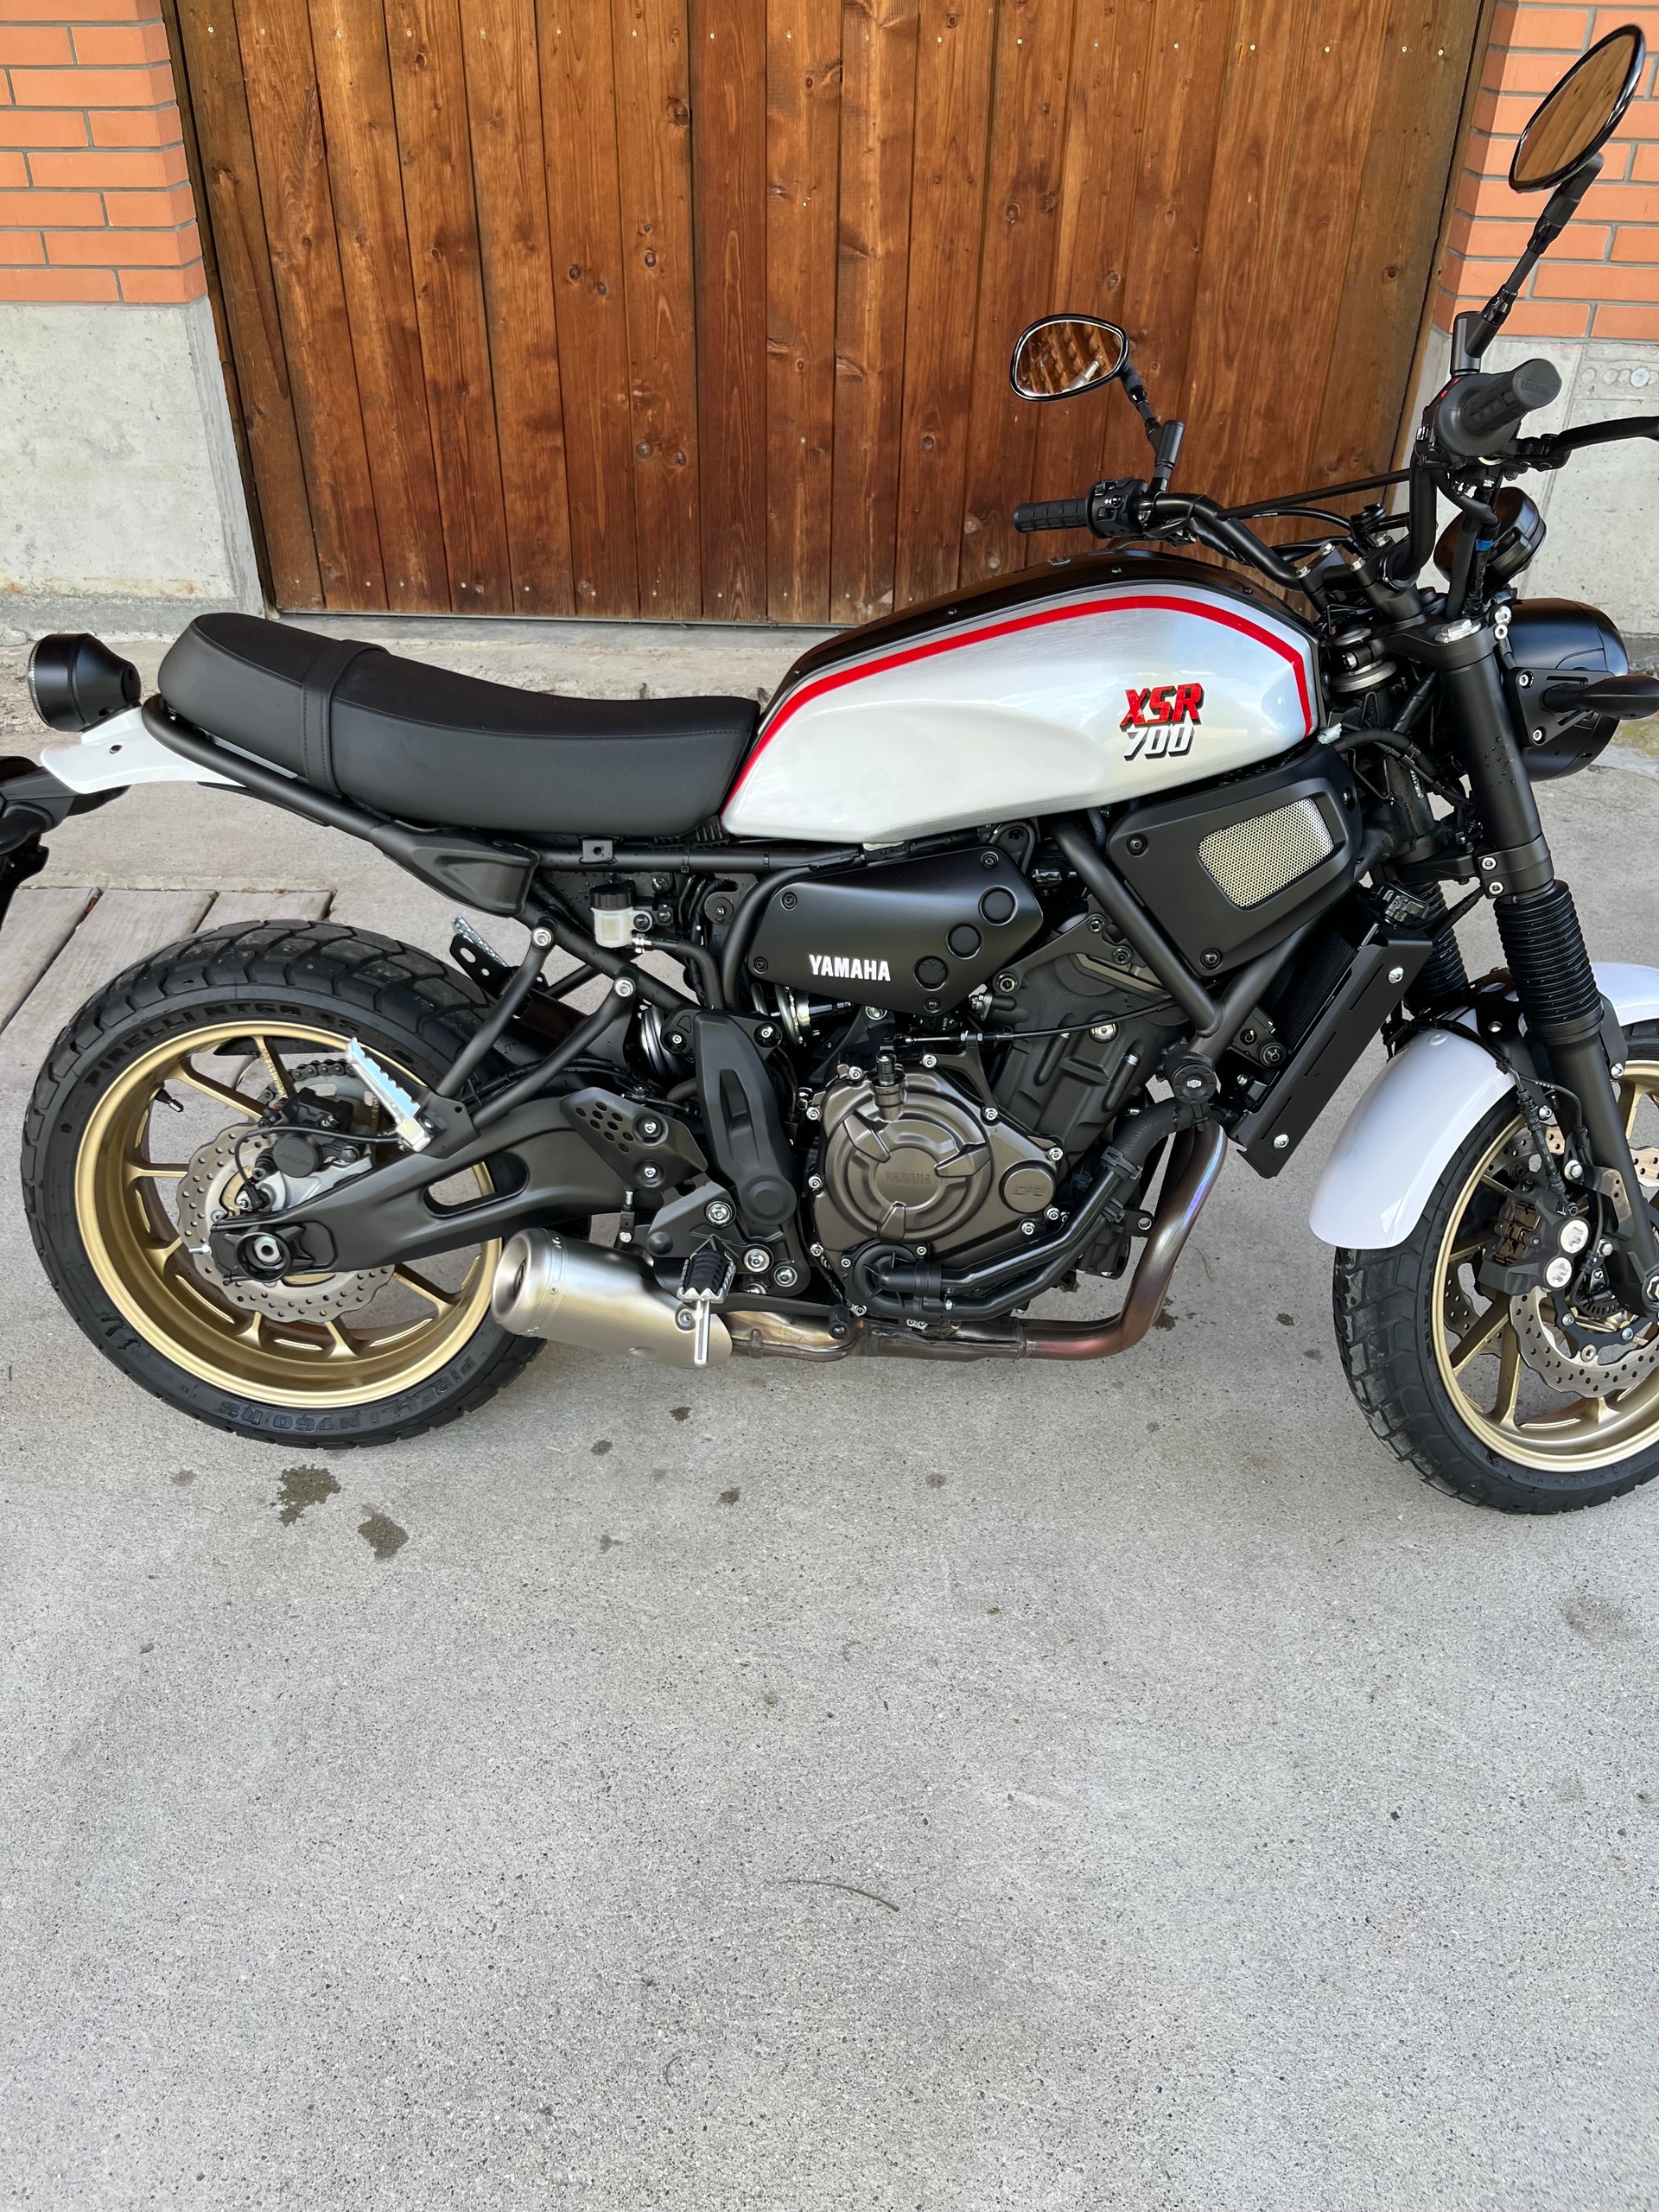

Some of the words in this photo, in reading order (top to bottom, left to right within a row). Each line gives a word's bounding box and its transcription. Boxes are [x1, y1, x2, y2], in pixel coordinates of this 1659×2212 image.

[1120, 682, 1205, 730] XSR
[1124, 724, 1195, 761] 700
[809, 954, 891, 982] YAMAHA
[85, 1011, 197, 1086] PIRELLI
[886, 1171, 932, 1185] YAMAHA
